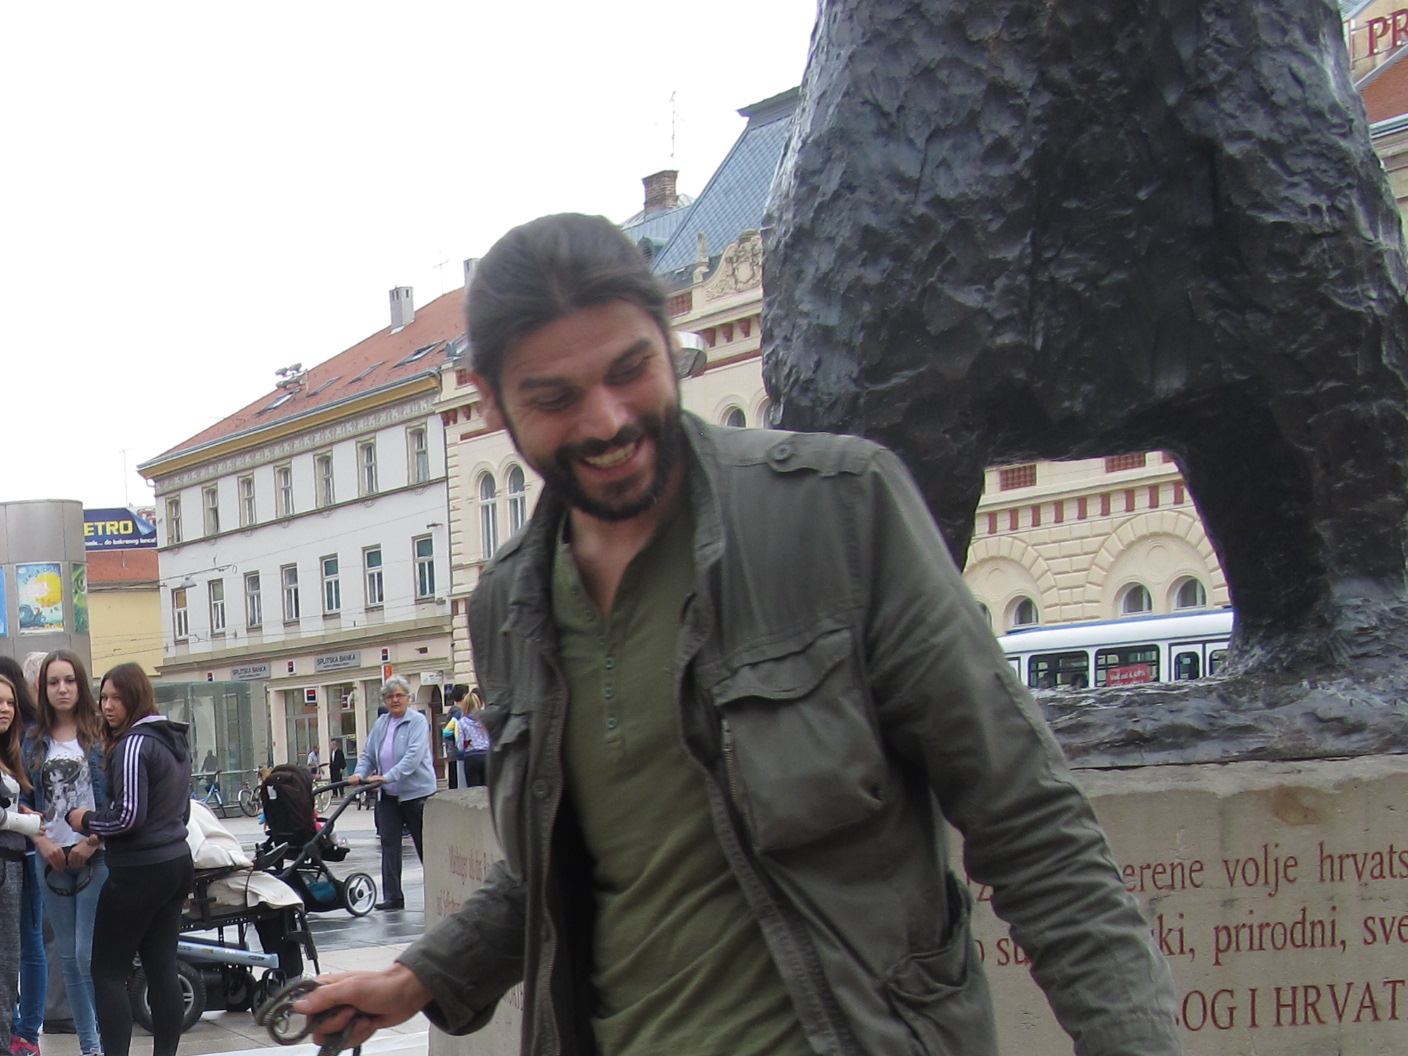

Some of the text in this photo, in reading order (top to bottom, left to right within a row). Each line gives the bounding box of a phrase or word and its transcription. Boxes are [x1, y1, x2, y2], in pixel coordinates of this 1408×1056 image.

[83, 520, 133, 536] ETRO
[1122, 859, 1205, 892] erene
[1222, 843, 1298, 897] volje
[1318, 840, 1408, 883] hrvats
[1155, 912, 1195, 963] ki,
[1212, 905, 1347, 966] prirodni,
[1363, 914, 1408, 946] sve
[1179, 979, 1408, 1032] OG I HRVAT
